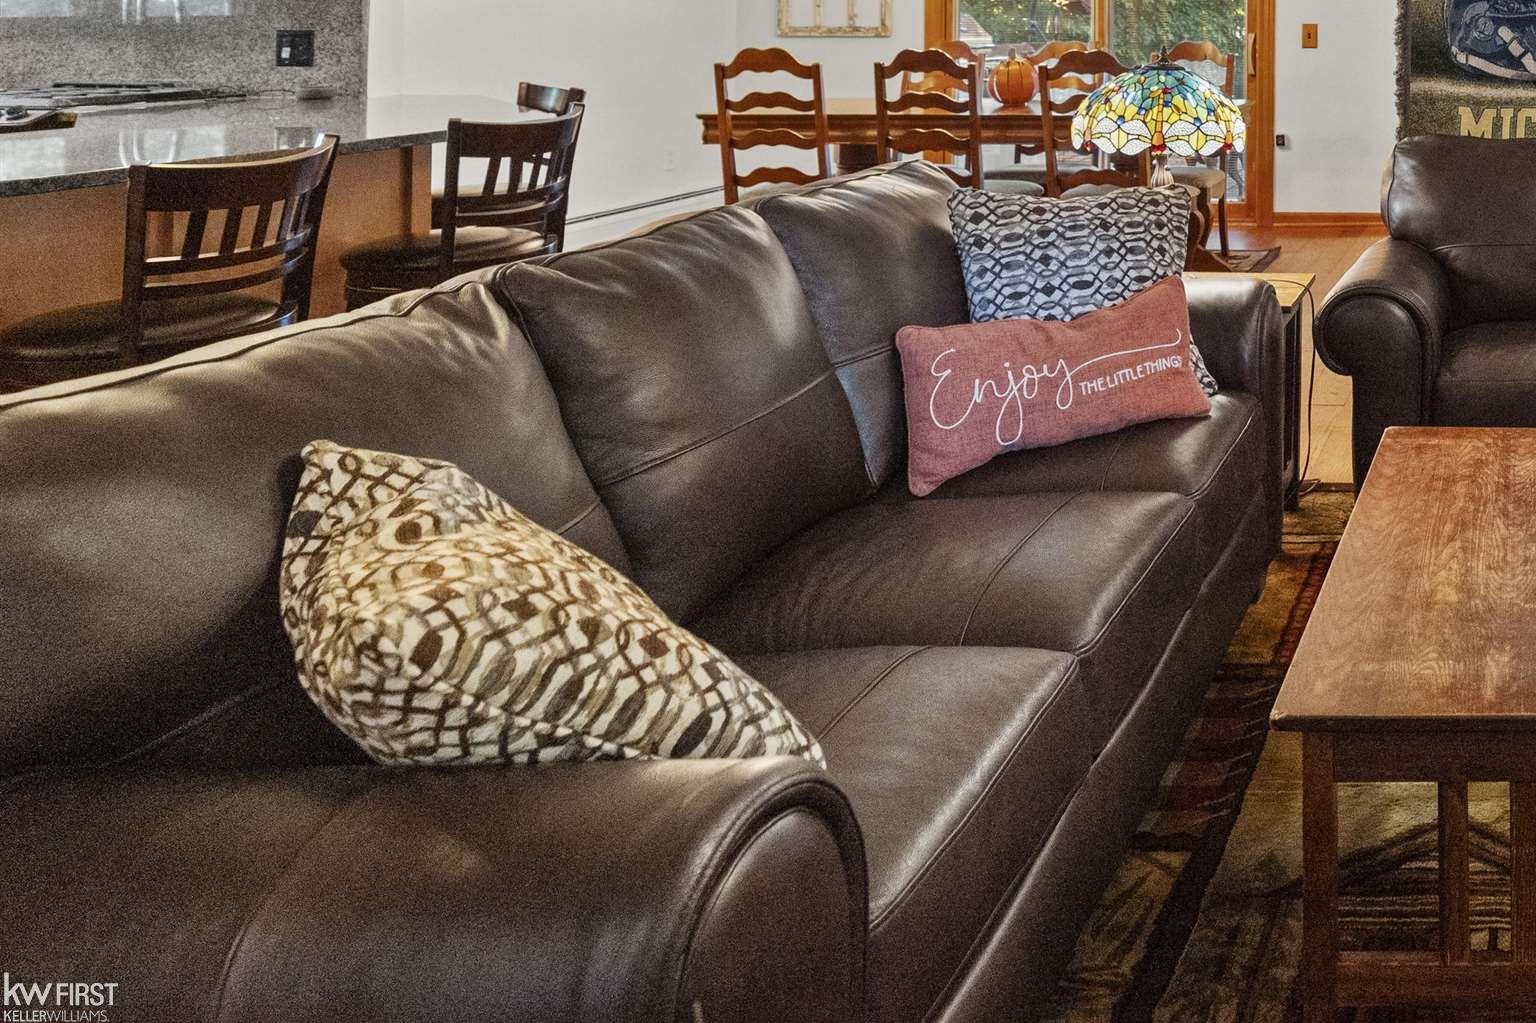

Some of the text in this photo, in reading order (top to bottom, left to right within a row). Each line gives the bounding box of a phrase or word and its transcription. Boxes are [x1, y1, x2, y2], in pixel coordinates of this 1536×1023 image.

[929, 328, 1181, 445] Enjoy
[1079, 356, 1182, 395] THE LITTLE THINGS
